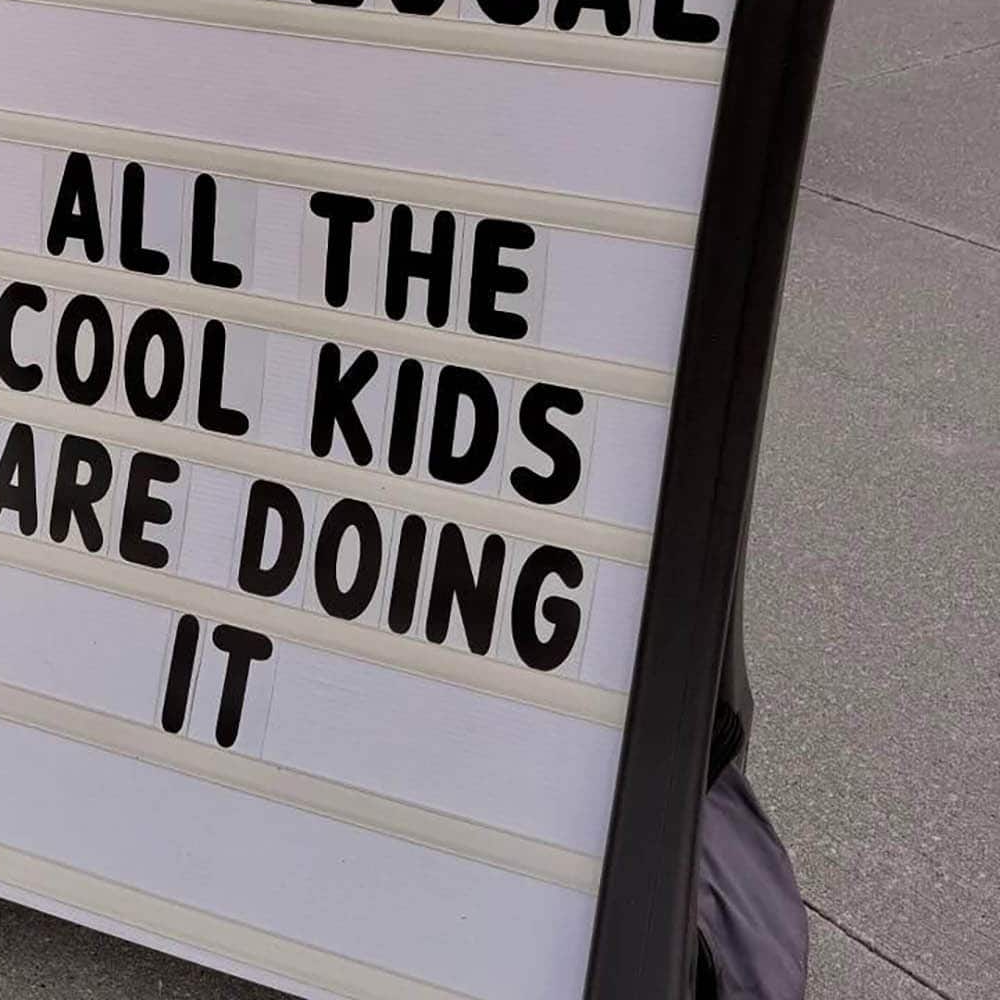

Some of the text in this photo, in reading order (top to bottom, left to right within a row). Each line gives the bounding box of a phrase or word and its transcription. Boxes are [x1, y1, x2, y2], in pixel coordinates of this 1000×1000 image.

[46, 151, 536, 341] ALL THE
[310, 342, 584, 505] KIDS
[237, 479, 584, 672] DOING
[161, 613, 273, 748] IT
